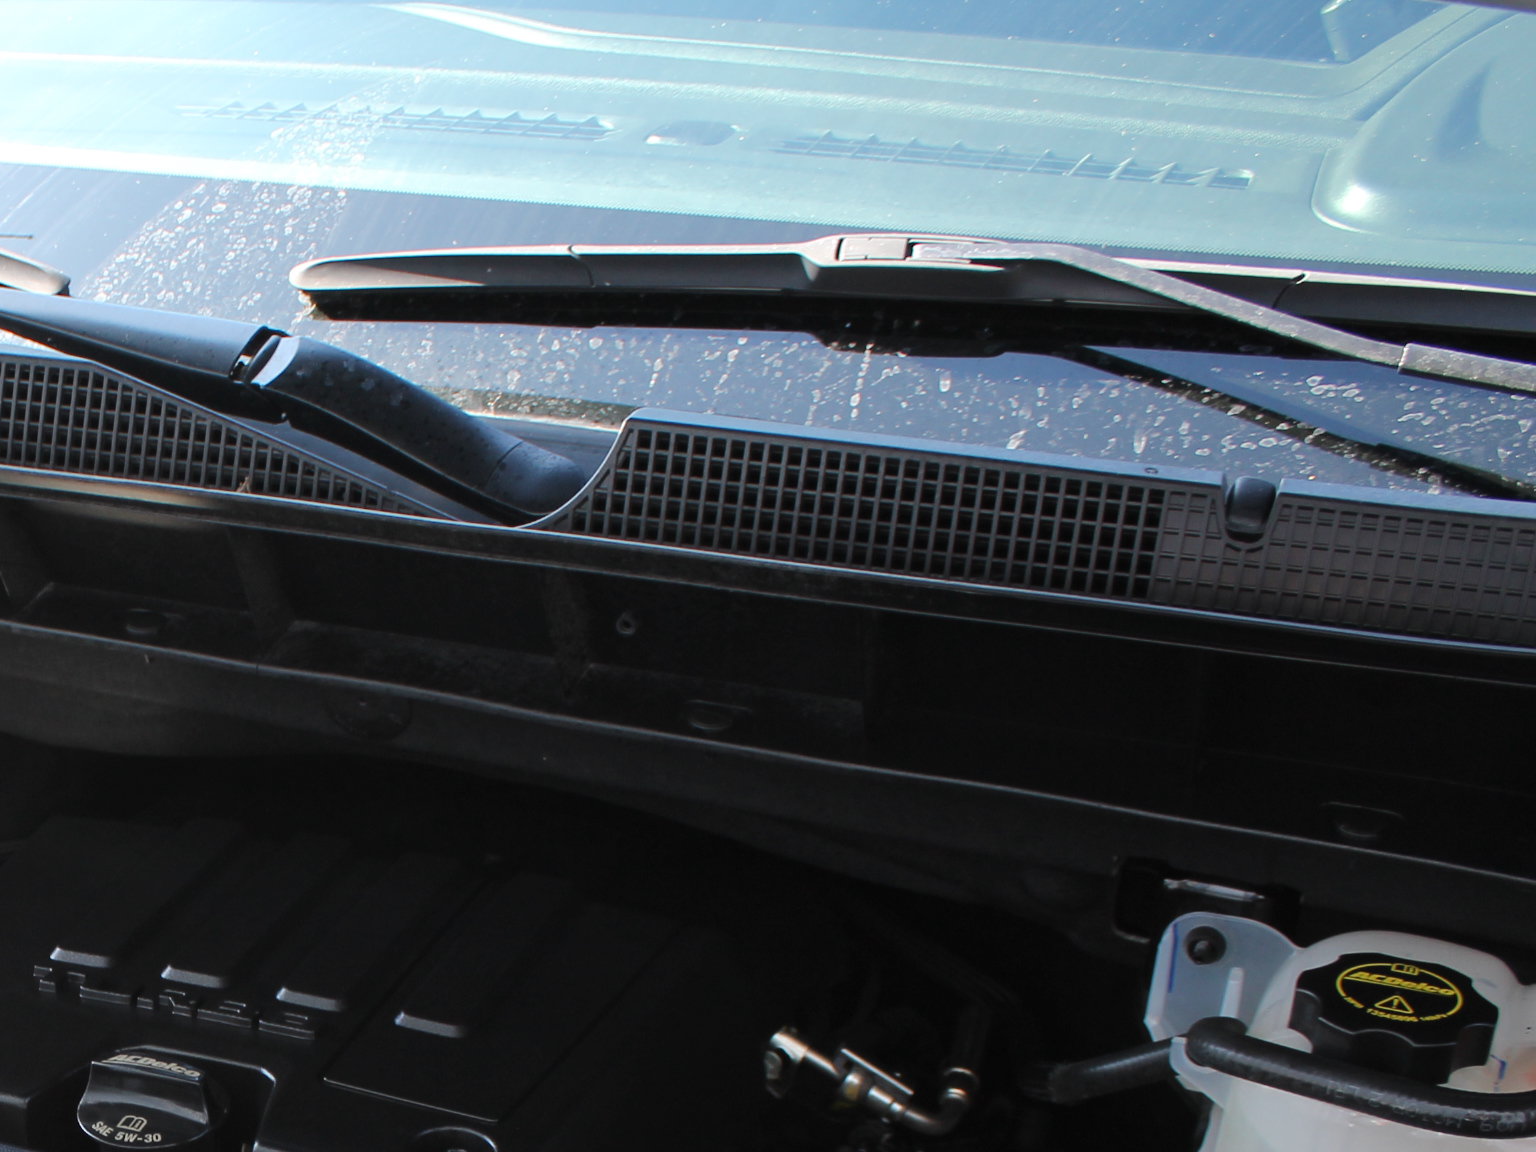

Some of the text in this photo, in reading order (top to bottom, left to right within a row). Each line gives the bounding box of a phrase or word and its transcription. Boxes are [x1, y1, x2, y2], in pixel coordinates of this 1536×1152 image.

[1346, 971, 1456, 996] ACDelco
[102, 1054, 202, 1078] ACDelco
[91, 1121, 162, 1143] SAE 5W-30
